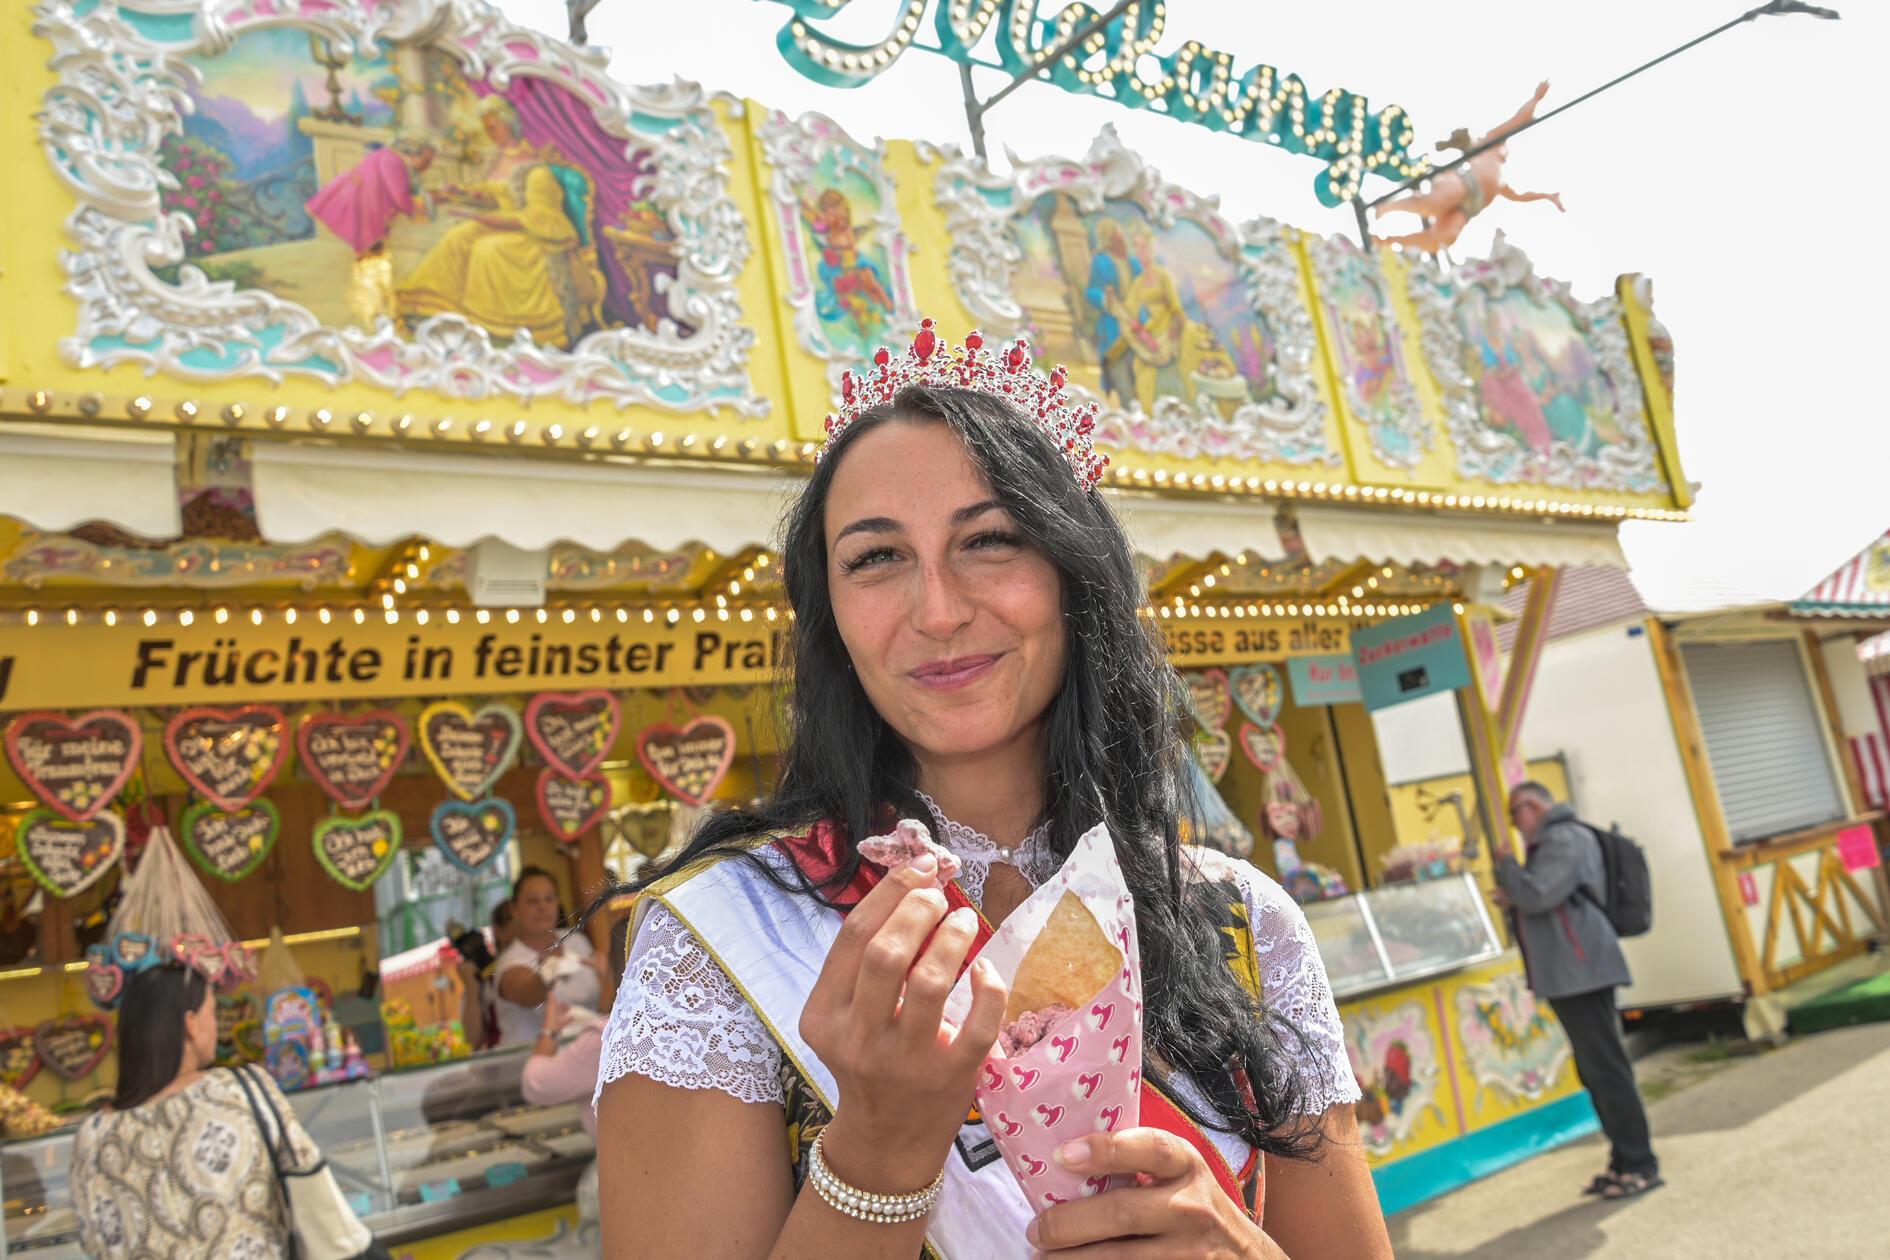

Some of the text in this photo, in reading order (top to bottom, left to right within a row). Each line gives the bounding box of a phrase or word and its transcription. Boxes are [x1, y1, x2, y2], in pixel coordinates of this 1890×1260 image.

[1234, 629, 1281, 653] aus
[1290, 621, 1342, 651] aller
[131, 637, 383, 689] Früchte
[403, 635, 454, 679] in
[475, 633, 674, 677] feinster
